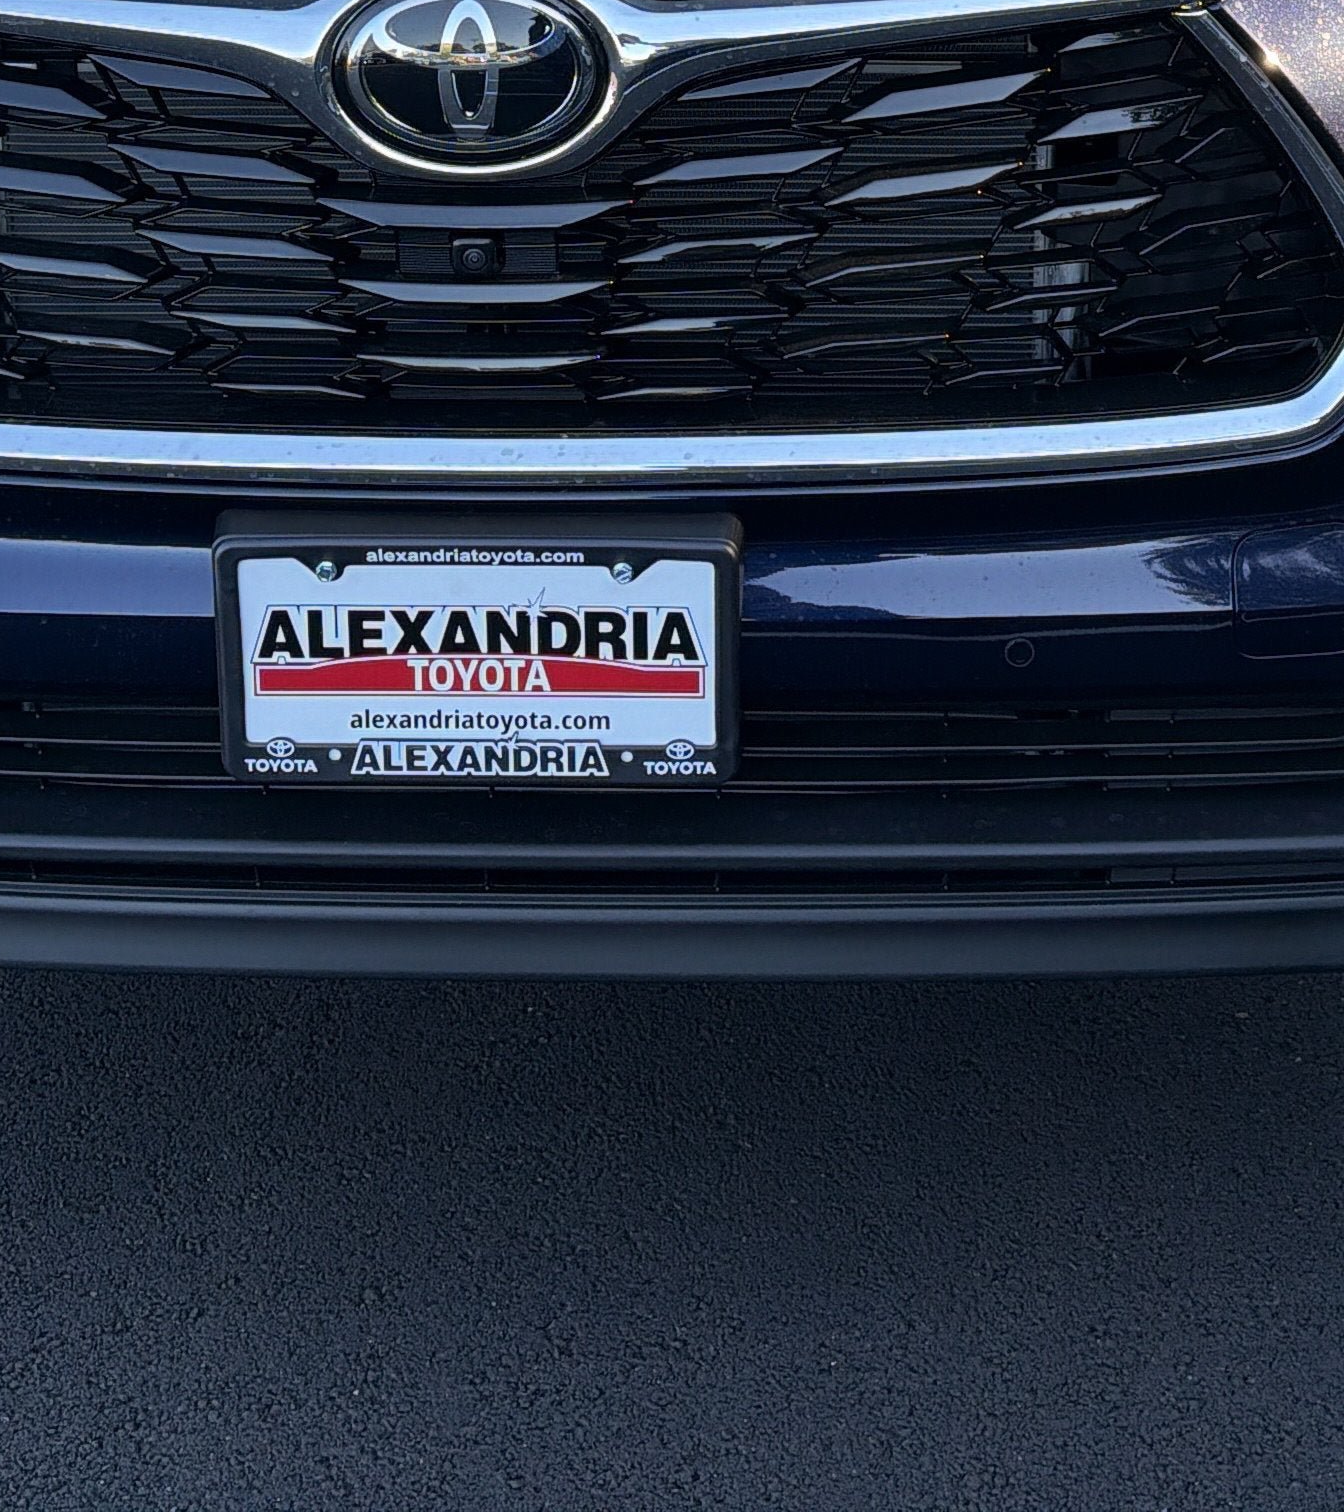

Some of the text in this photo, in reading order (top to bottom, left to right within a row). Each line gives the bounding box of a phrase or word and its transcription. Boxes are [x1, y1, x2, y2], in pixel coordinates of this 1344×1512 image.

[365, 548, 585, 566] alexandriatoyota.com
[257, 609, 700, 661] ALEXANDRIA
[406, 659, 552, 692] TOYOTA
[350, 709, 611, 735] alexandriatoyota.com
[244, 758, 318, 773] TOYOTA
[353, 742, 607, 775] ALEXANDRIA
[643, 761, 717, 776] TOYOTA
